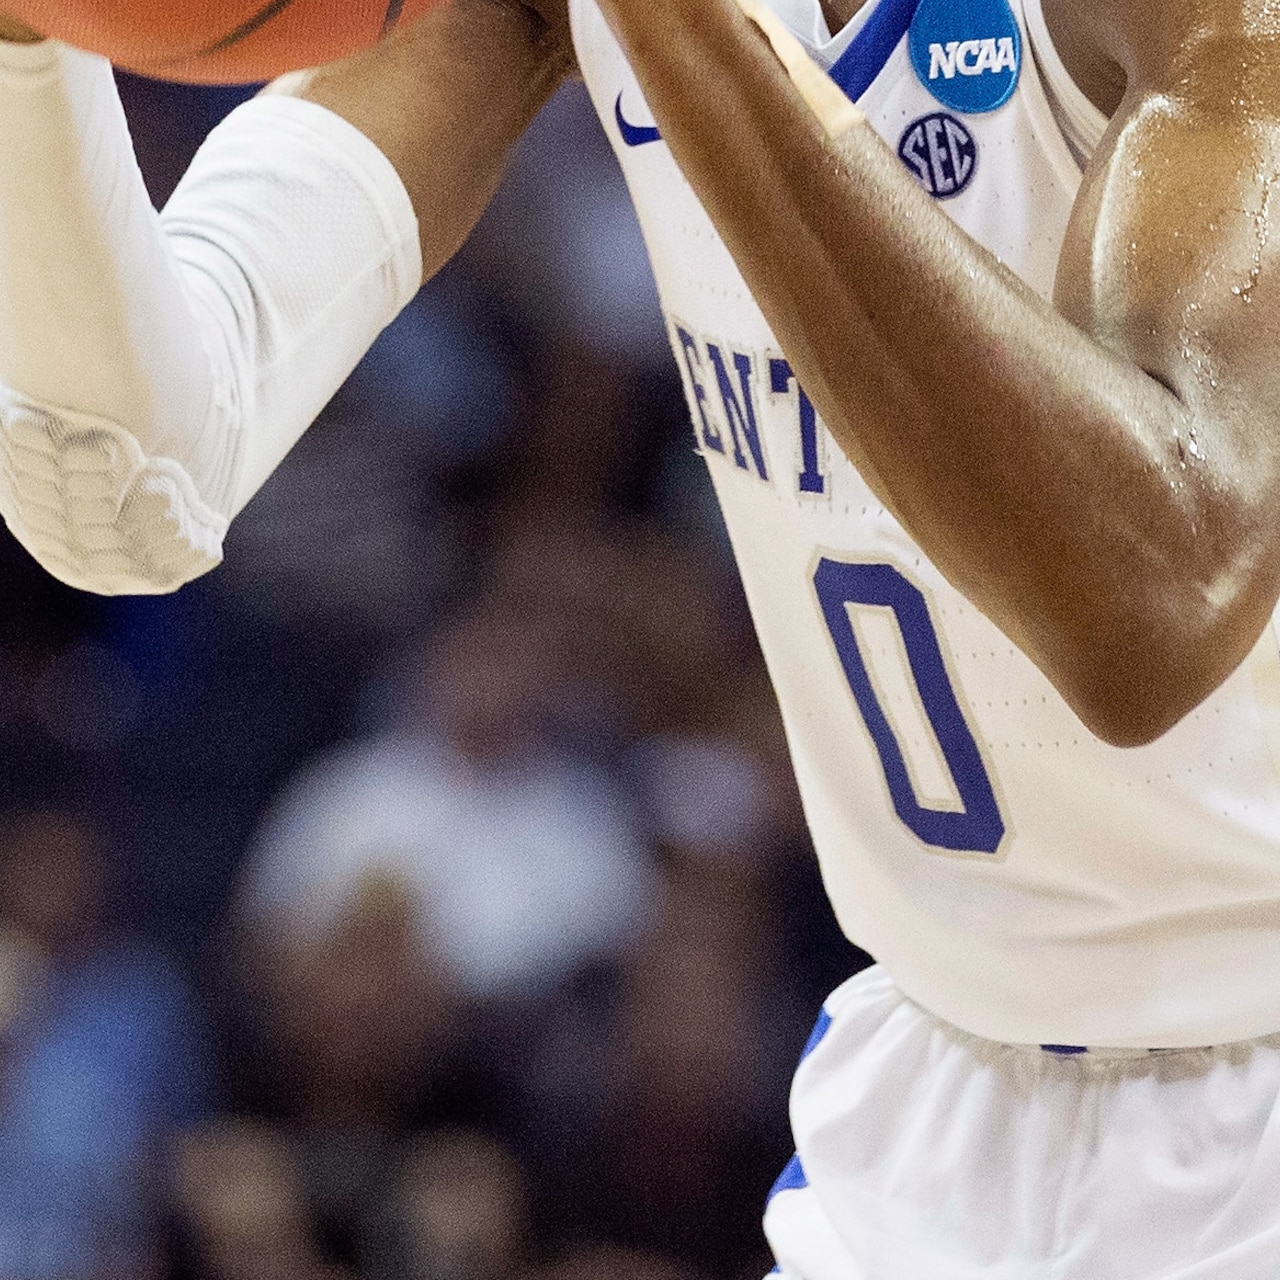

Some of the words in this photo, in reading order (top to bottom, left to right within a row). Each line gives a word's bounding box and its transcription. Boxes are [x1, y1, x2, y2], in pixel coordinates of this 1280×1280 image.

[927, 36, 1017, 80] NCAA
[901, 117, 973, 194] SEC
[812, 554, 1007, 855] 0
